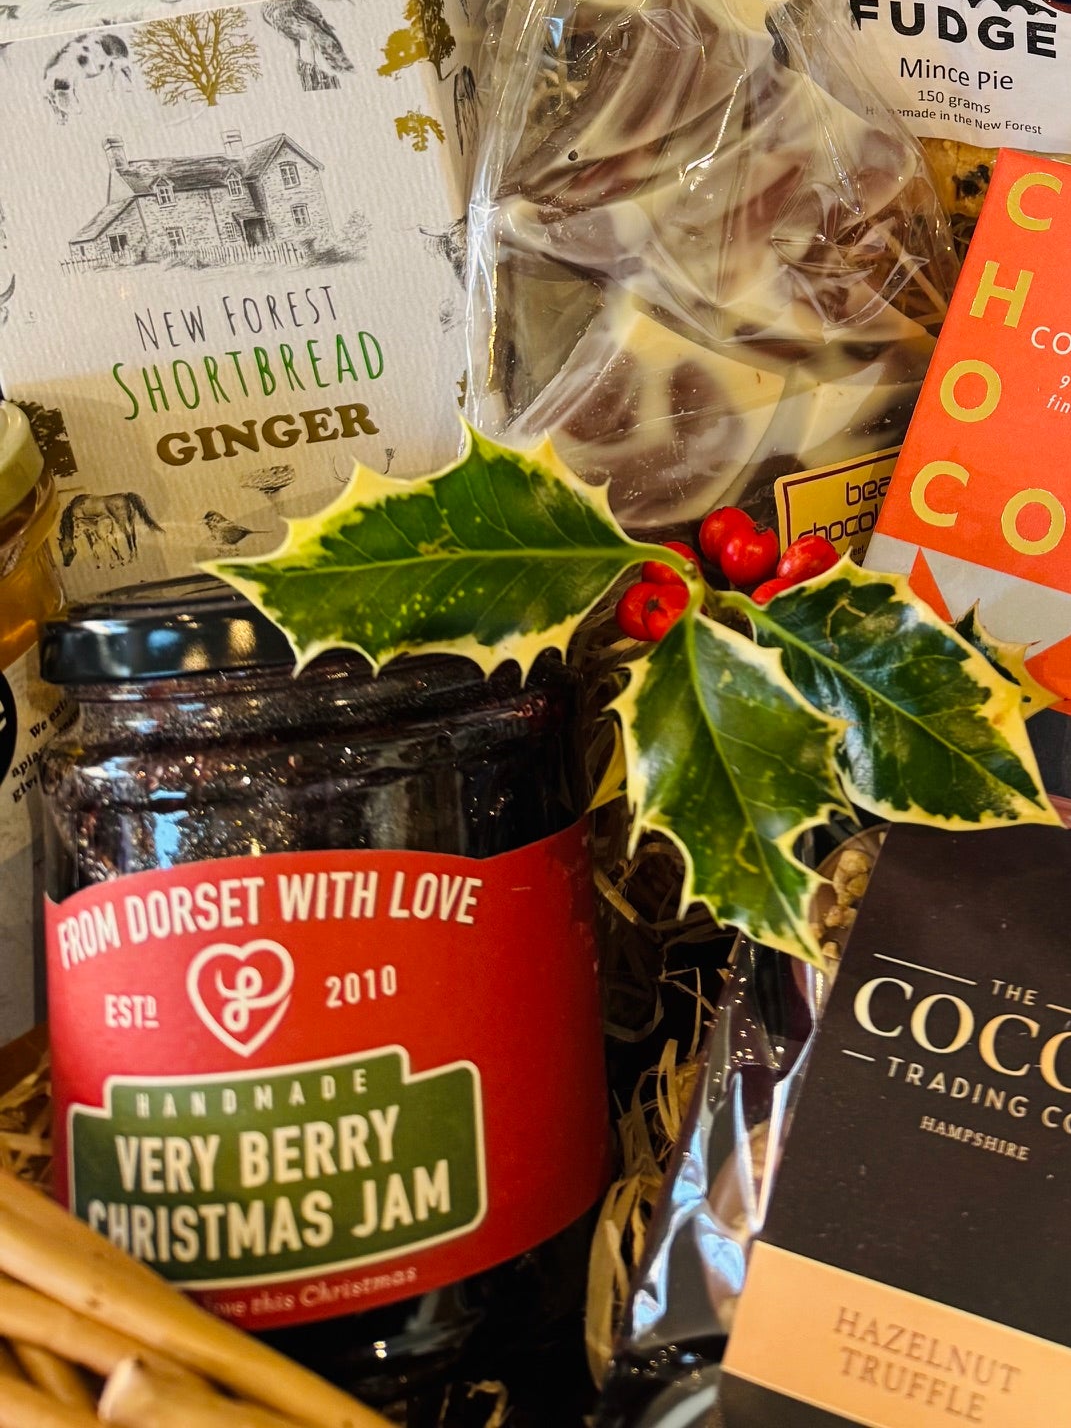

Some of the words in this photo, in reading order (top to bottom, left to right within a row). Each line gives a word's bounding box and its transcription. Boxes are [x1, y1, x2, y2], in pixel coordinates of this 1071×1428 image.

[900, 57, 970, 88] Mince
[977, 71, 1013, 90] Pie
[918, 90, 944, 104] 150
[949, 96, 991, 114] grams
[940, 110, 950, 121] in
[954, 113, 972, 126] the
[975, 119, 1001, 131] New
[1005, 121, 1042, 135] Forest
[135, 307, 207, 352] NEW
[221, 285, 341, 339] FOREST
[111, 329, 386, 423] SHORTBREAD
[1058, 375, 1071, 390] 9
[156, 402, 380, 467] GINGER
[57, 899, 120, 970] FROM
[125, 876, 265, 944] DORSET
[277, 871, 378, 922] WITH
[388, 871, 483, 925] LOVE
[325, 965, 398, 1009] 2010
[991, 979, 1038, 1006] THE
[135, 1068, 368, 1119] HANDMADE
[886, 1056, 1028, 1119] TRADING
[114, 1134, 220, 1193] VERY
[239, 1105, 399, 1189] BERRY
[920, 1115, 1030, 1162] HAMPSHIRE
[351, 1159, 451, 1239] JAM
[300, 1266, 418, 1307] Christmas
[834, 1306, 1022, 1394] HAZELNUT
[839, 1346, 986, 1423] TRUFFLE
